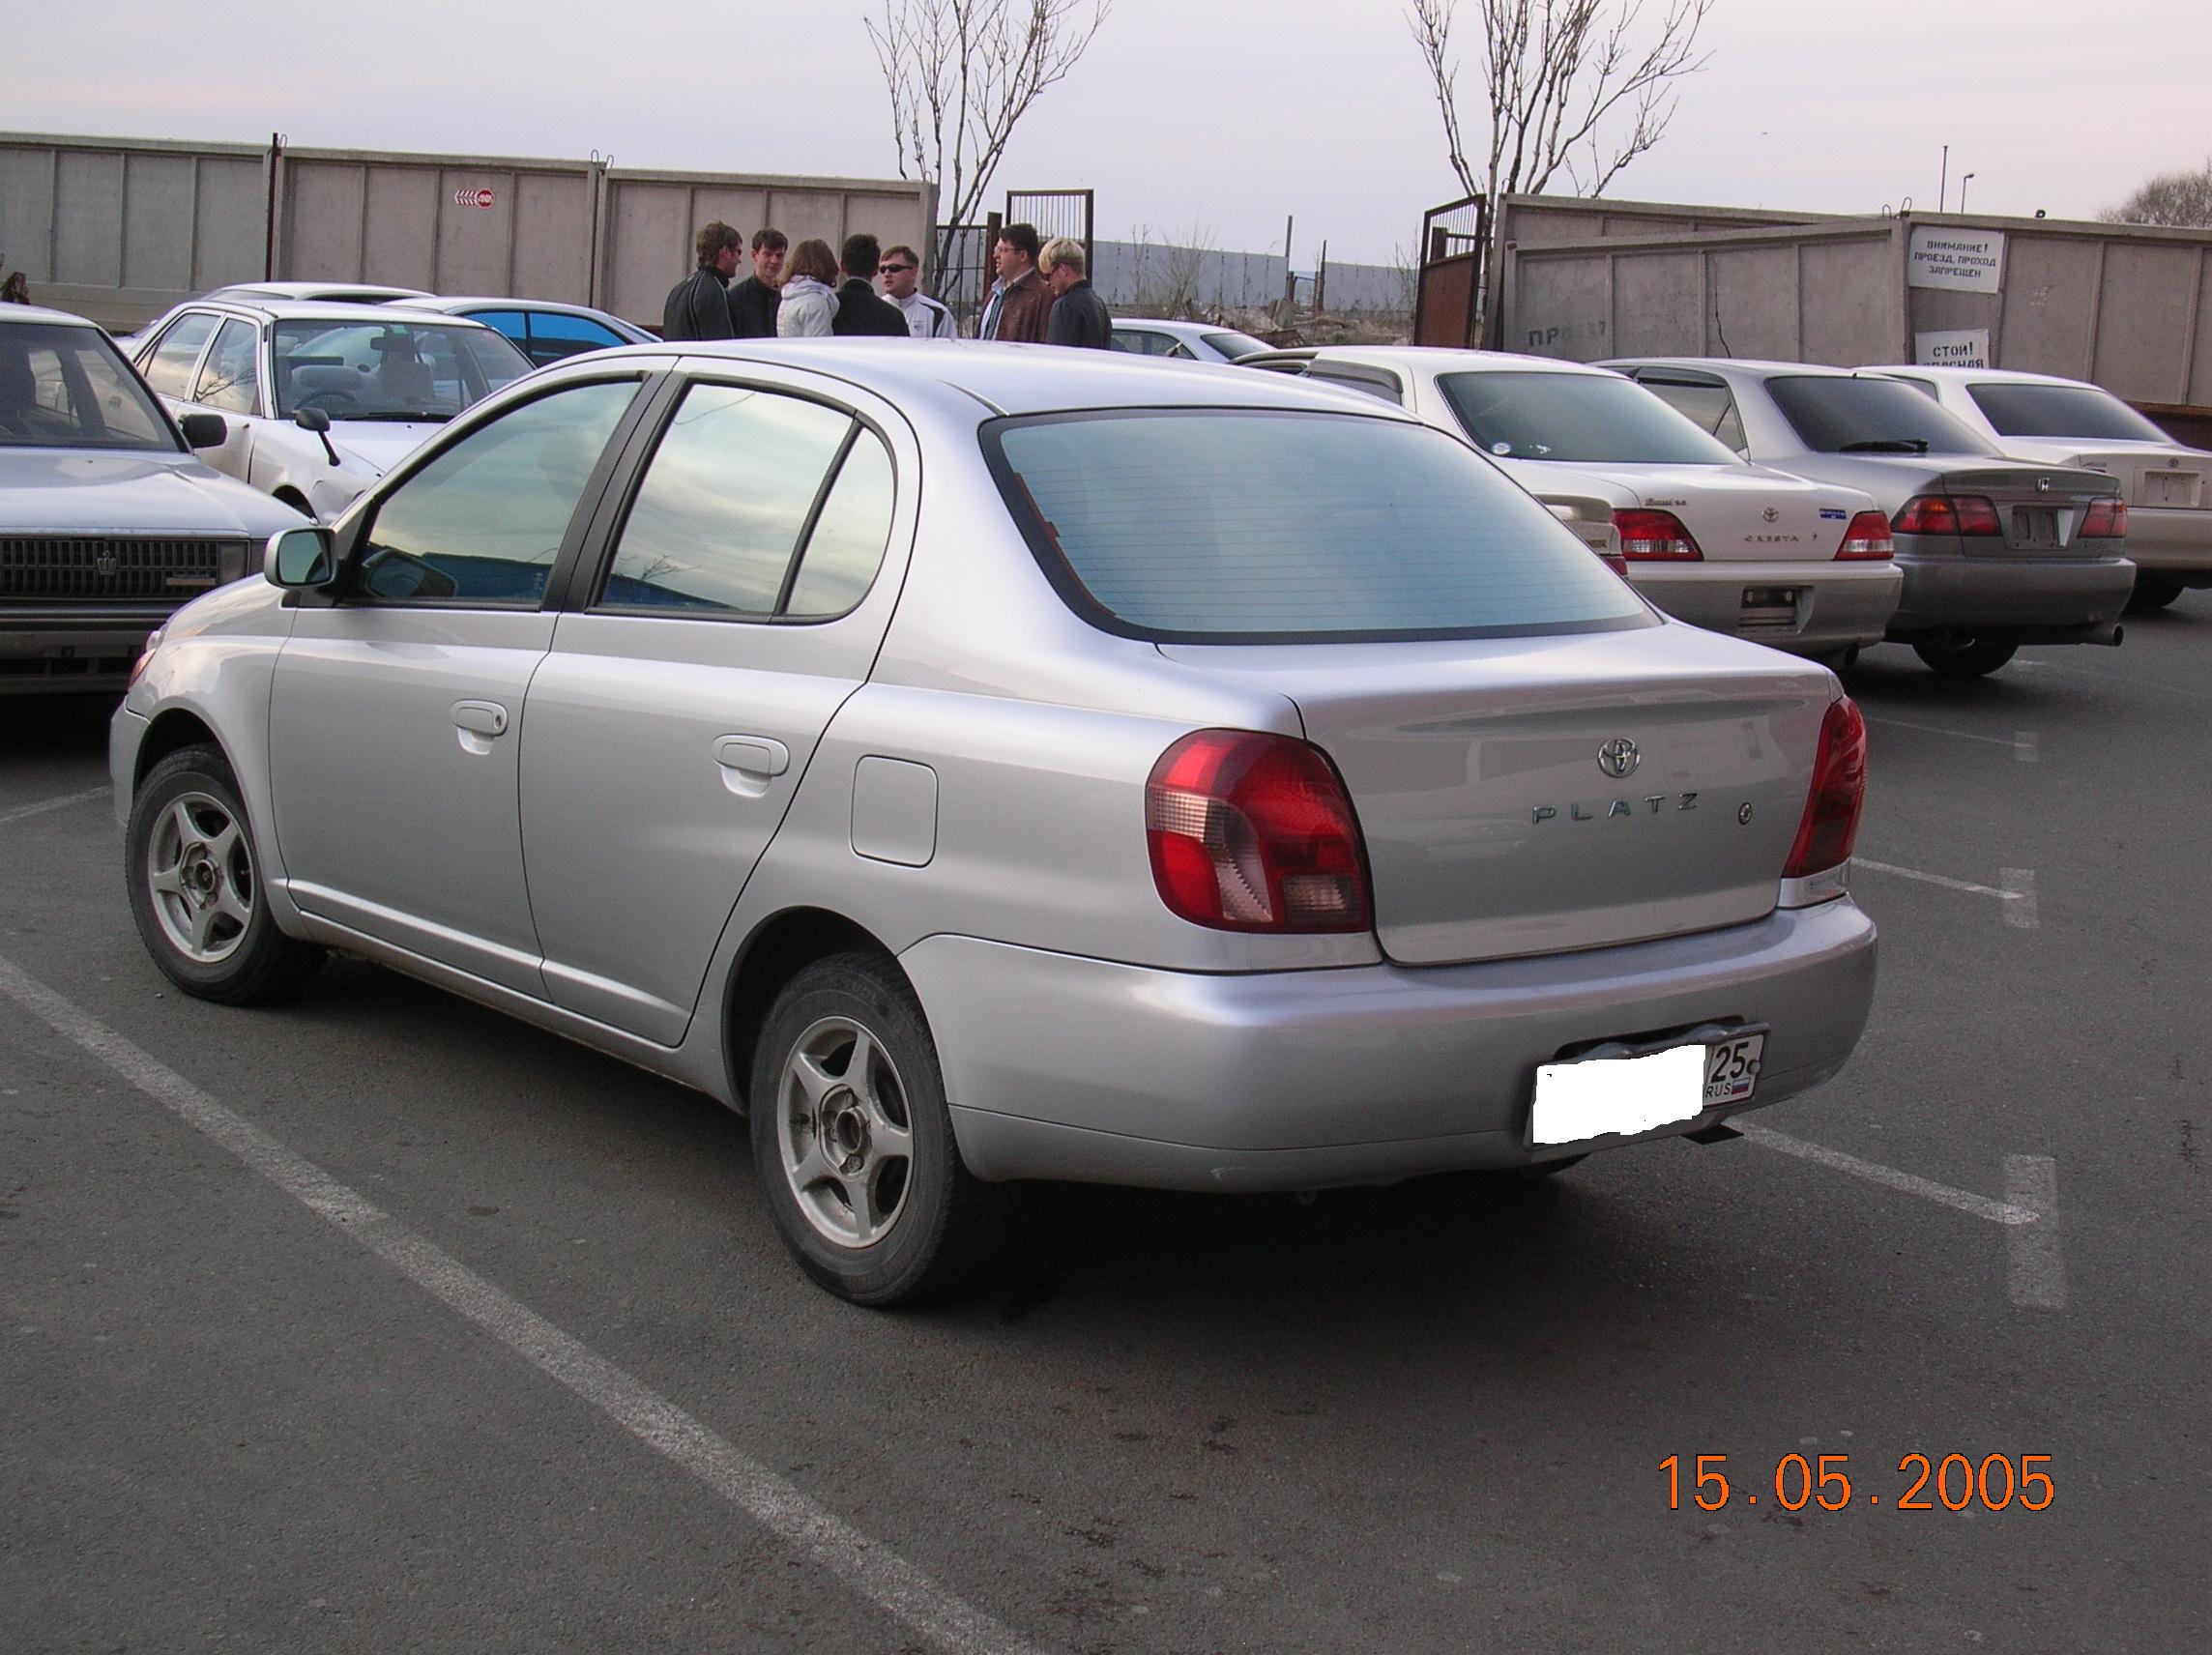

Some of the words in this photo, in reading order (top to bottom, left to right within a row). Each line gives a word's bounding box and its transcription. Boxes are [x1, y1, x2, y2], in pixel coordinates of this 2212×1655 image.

[1927, 240, 1989, 253] ВНИМАНИЕ!
[1958, 255, 1996, 267] ПРОХОД
[1531, 793, 1698, 823] PLATZ
[1711, 1041, 1749, 1083] 25
[1704, 1082, 1732, 1099] RUS
